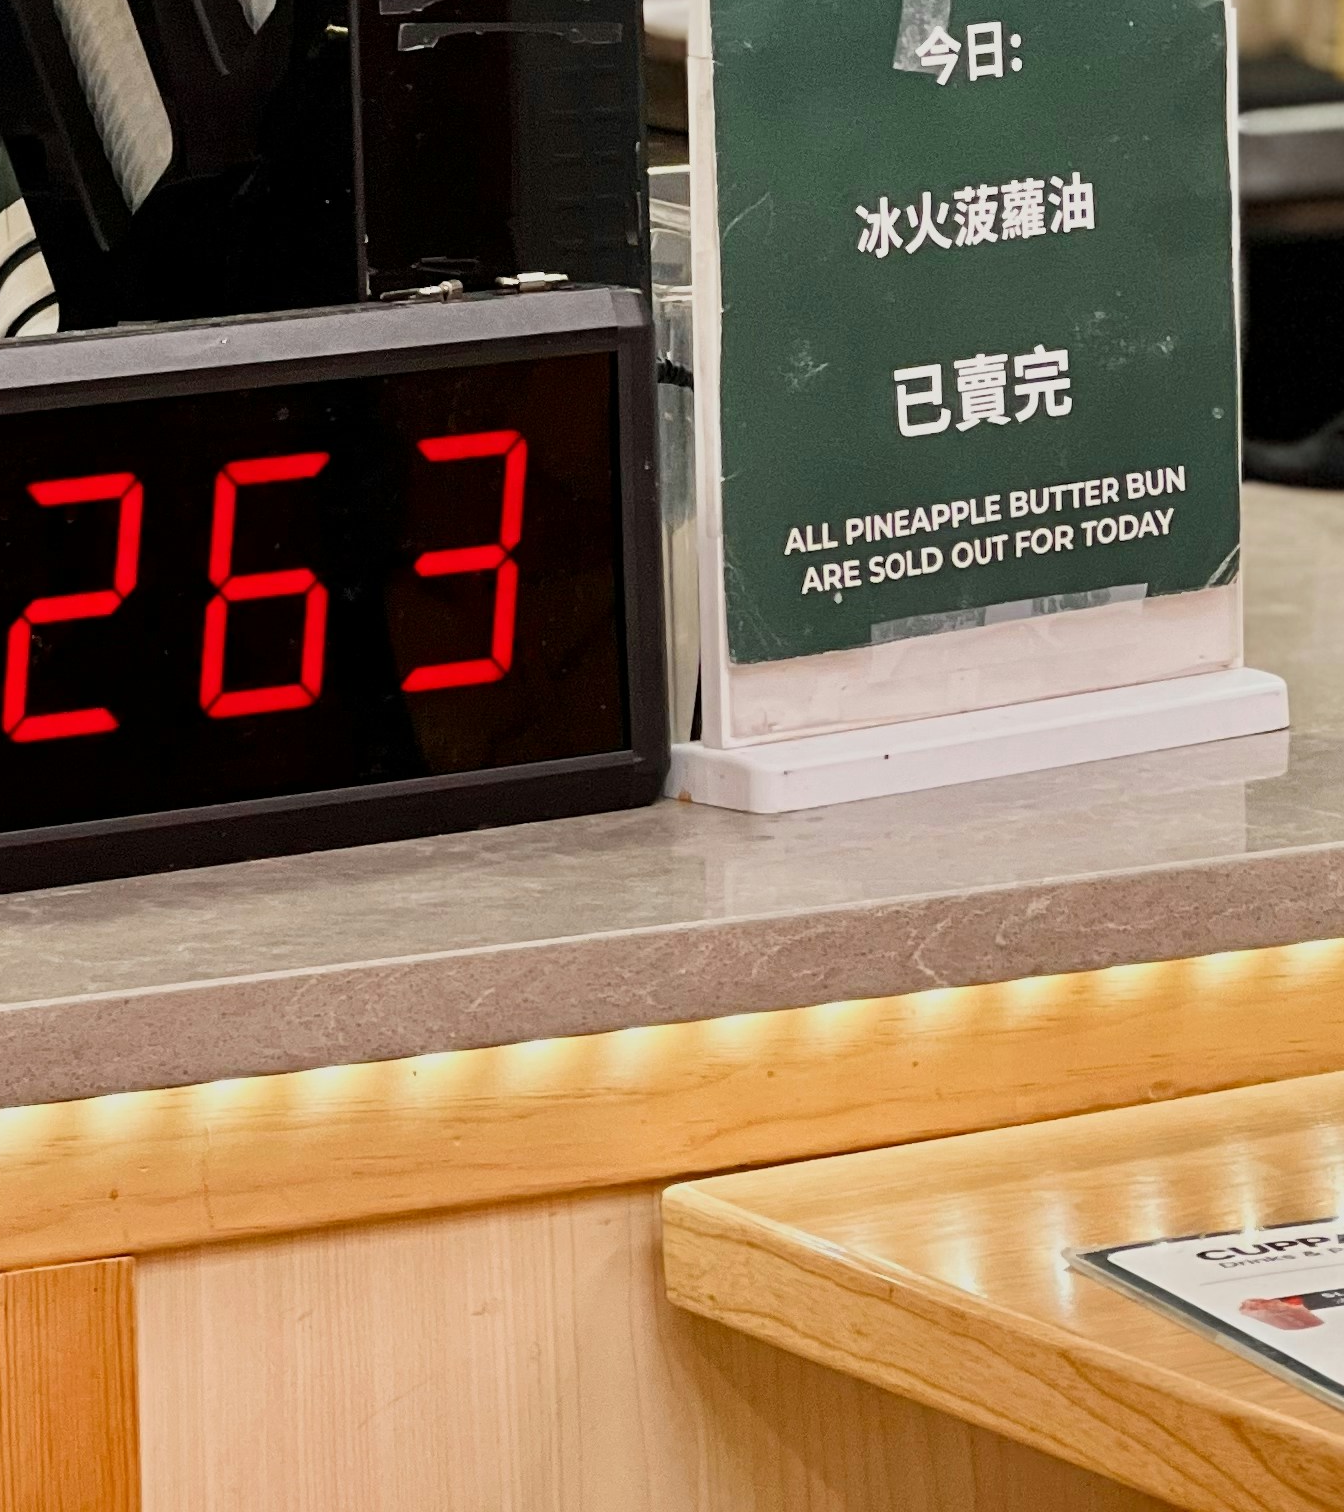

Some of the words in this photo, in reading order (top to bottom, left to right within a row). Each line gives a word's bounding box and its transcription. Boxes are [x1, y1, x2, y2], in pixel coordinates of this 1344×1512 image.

[855, 171, 1095, 258] 冰火菠蘿油
[893, 344, 1073, 437] 已賣完
[784, 525, 838, 555] ALL
[845, 494, 1001, 546] PINEAPPLE
[1009, 477, 1120, 518] BUTTER
[1125, 466, 1186, 498] BUN
[801, 560, 860, 594] ARE
[868, 546, 944, 584] SOLD
[951, 535, 1009, 568] OUT
[1014, 524, 1074, 557] FOR
[1080, 508, 1176, 548] TODAY
[3, 429, 528, 743] 263
